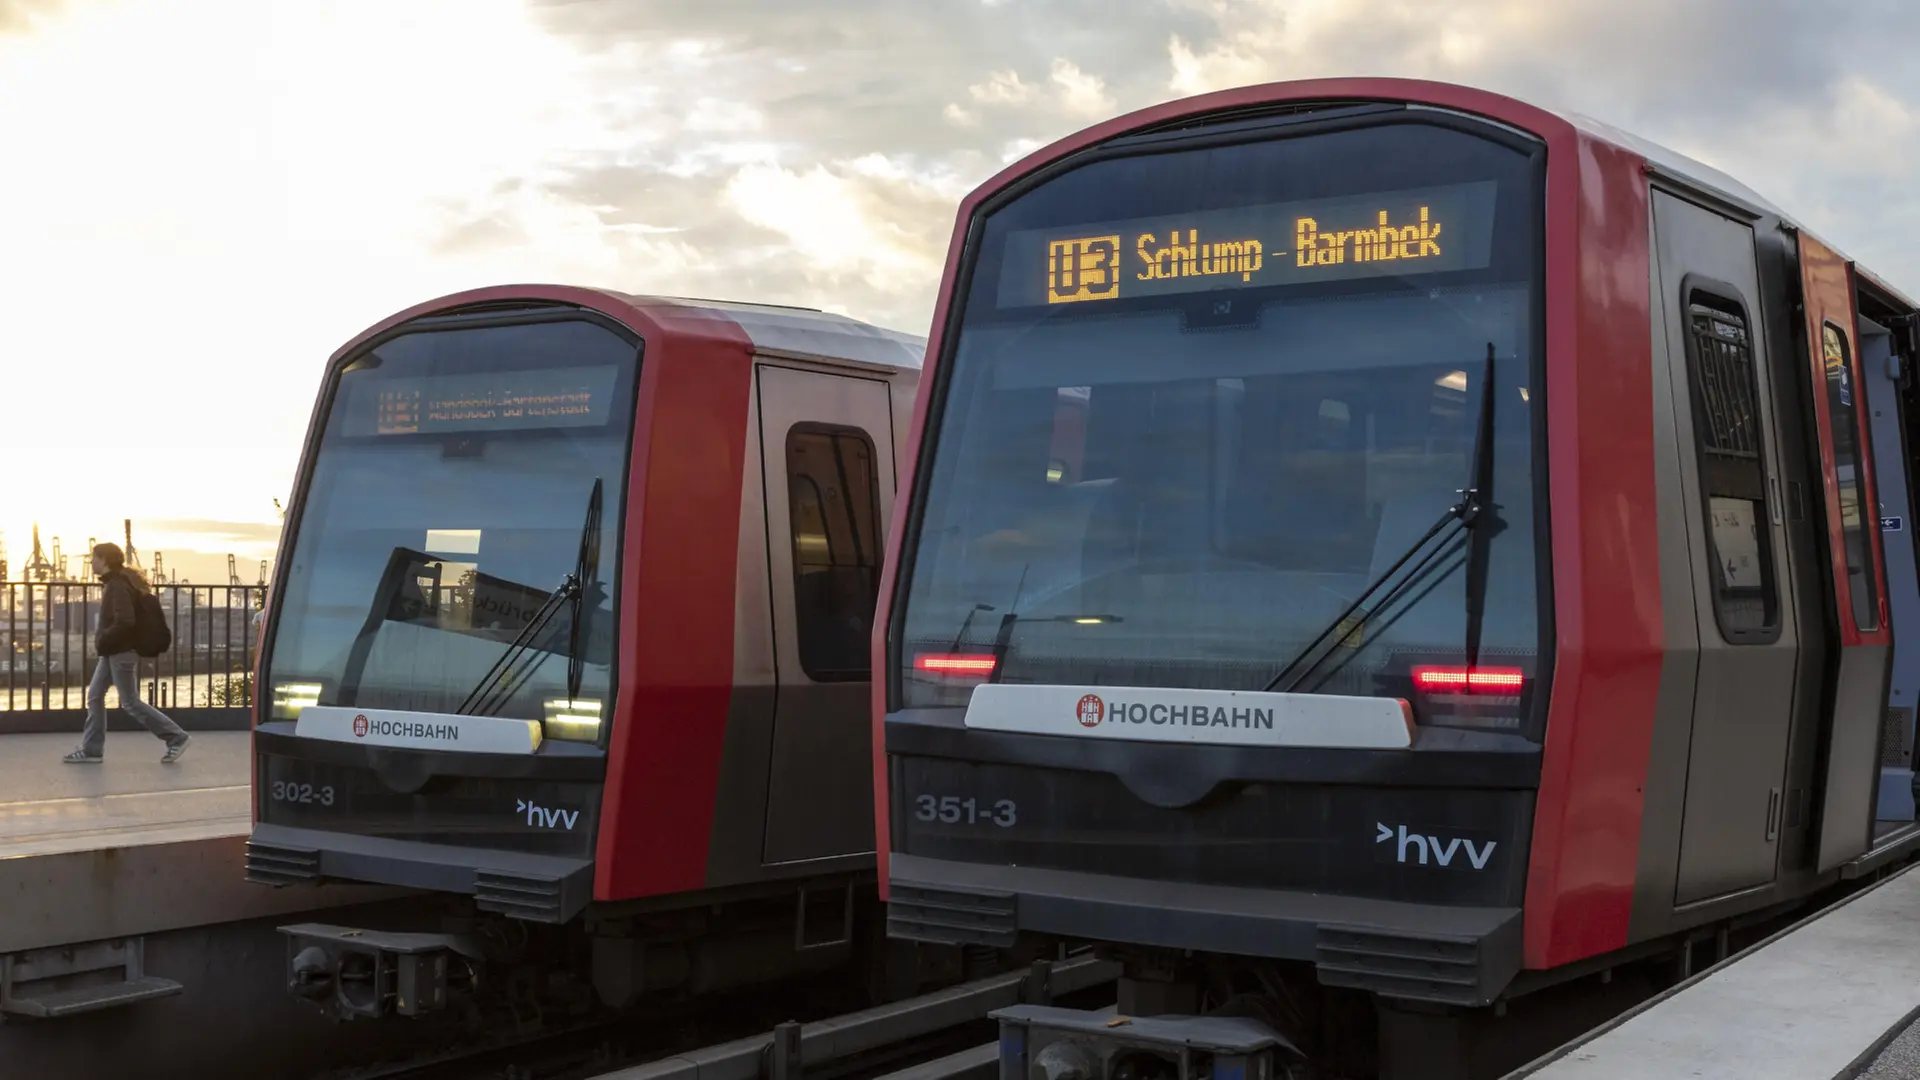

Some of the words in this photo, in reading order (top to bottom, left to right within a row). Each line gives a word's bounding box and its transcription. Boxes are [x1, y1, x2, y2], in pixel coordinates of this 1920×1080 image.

[1052, 237, 1117, 300] U3
[1136, 228, 1263, 283] Schlump
[1296, 205, 1441, 268] Barmbek
[1109, 702, 1275, 730] HOCHBAHN
[370, 720, 459, 741] HOCHBAHN
[272, 780, 335, 806] 302-3
[915, 794, 1018, 828] 351-3
